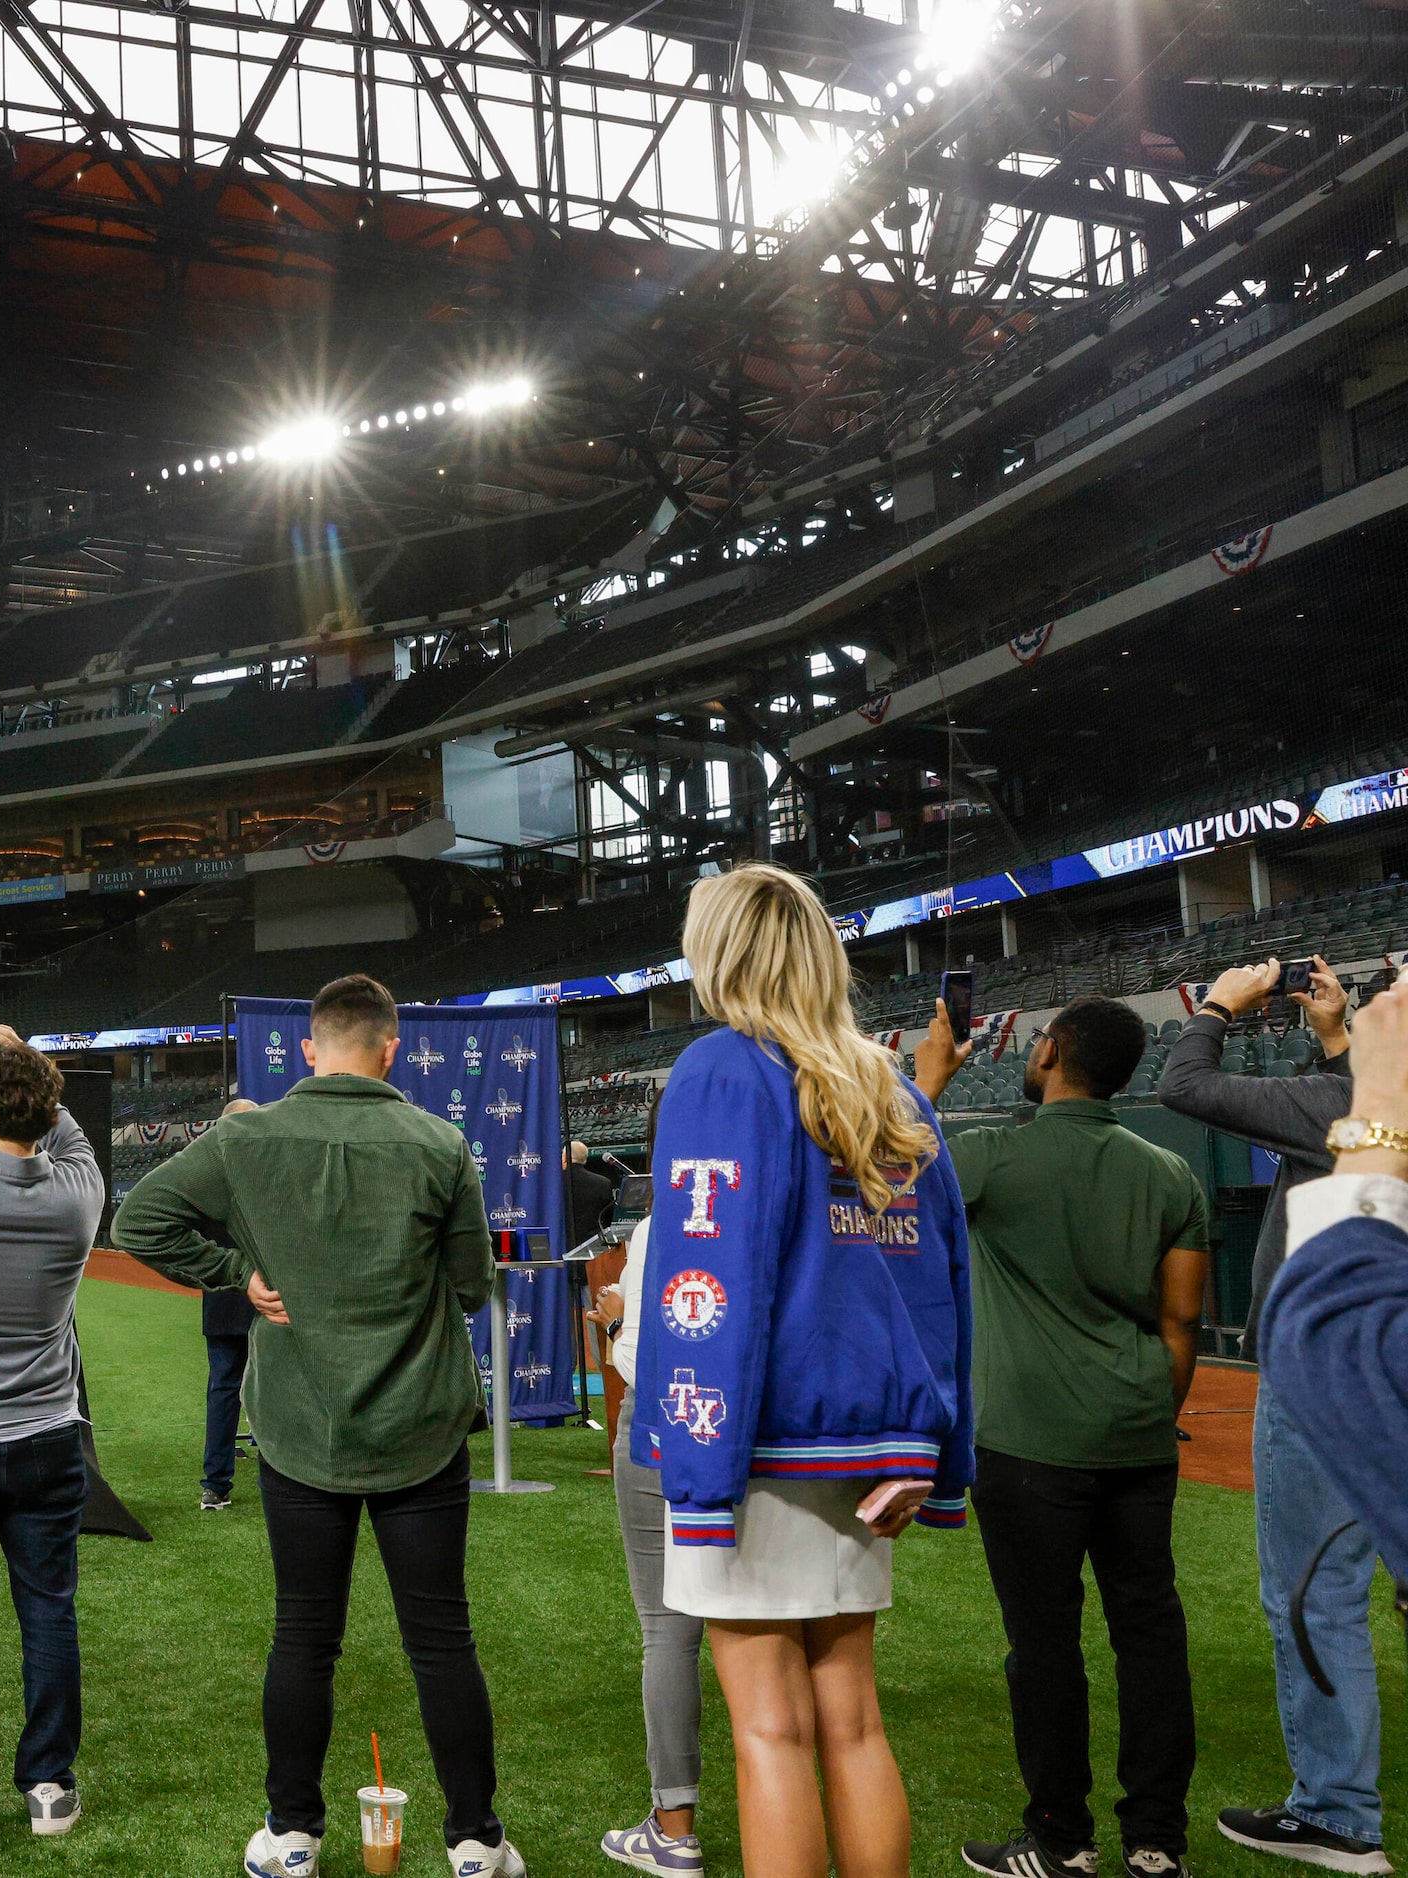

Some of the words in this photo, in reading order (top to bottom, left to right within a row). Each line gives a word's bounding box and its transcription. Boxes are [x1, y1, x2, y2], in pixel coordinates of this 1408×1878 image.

[1104, 799, 1301, 870] CHAMPIONS
[145, 865, 184, 879] PERRY
[194, 859, 234, 874] PERRY
[96, 871, 135, 885] PERRY
[152, 877, 178, 885] HOMES
[202, 872, 229, 880] HOMES
[21, 883, 54, 893] Service
[628, 968, 670, 994] CHAMPIONS
[37, 1039, 93, 1051] CHAMPIONS
[265, 1046, 286, 1056] Globe
[463, 1050, 483, 1059] Globe
[500, 1051, 537, 1061] CHAMPIONS
[269, 1055, 283, 1065] Life
[407, 1054, 445, 1063] CHAMPIONS
[467, 1058, 480, 1067] Life
[268, 1065, 285, 1074] Field
[421, 1062, 430, 1075] T
[515, 1059, 524, 1072] T
[466, 1067, 482, 1076] Field
[447, 1103, 467, 1112] Globe
[485, 1104, 523, 1114] CHAMPIONS
[450, 1111, 464, 1120] Life
[499, 1112, 509, 1126] T
[473, 1155, 488, 1163] lobe
[507, 1156, 542, 1166] CHAMPIONS
[519, 1164, 528, 1178] T
[671, 1158, 741, 1238] T
[490, 1209, 527, 1220] CHAMPIONS
[525, 1270, 535, 1283] T
[669, 1271, 719, 1290] TEXAS
[682, 1291, 706, 1321] T
[507, 1315, 532, 1325] MPIONS
[664, 1310, 724, 1338] RANGERS
[514, 1367, 552, 1378] CHAMPIONS
[528, 1375, 536, 1389] T
[385, 1819, 394, 1841] ICED
[289, 1851, 309, 1862] NIKE
[462, 1860, 483, 1871] NIKE
